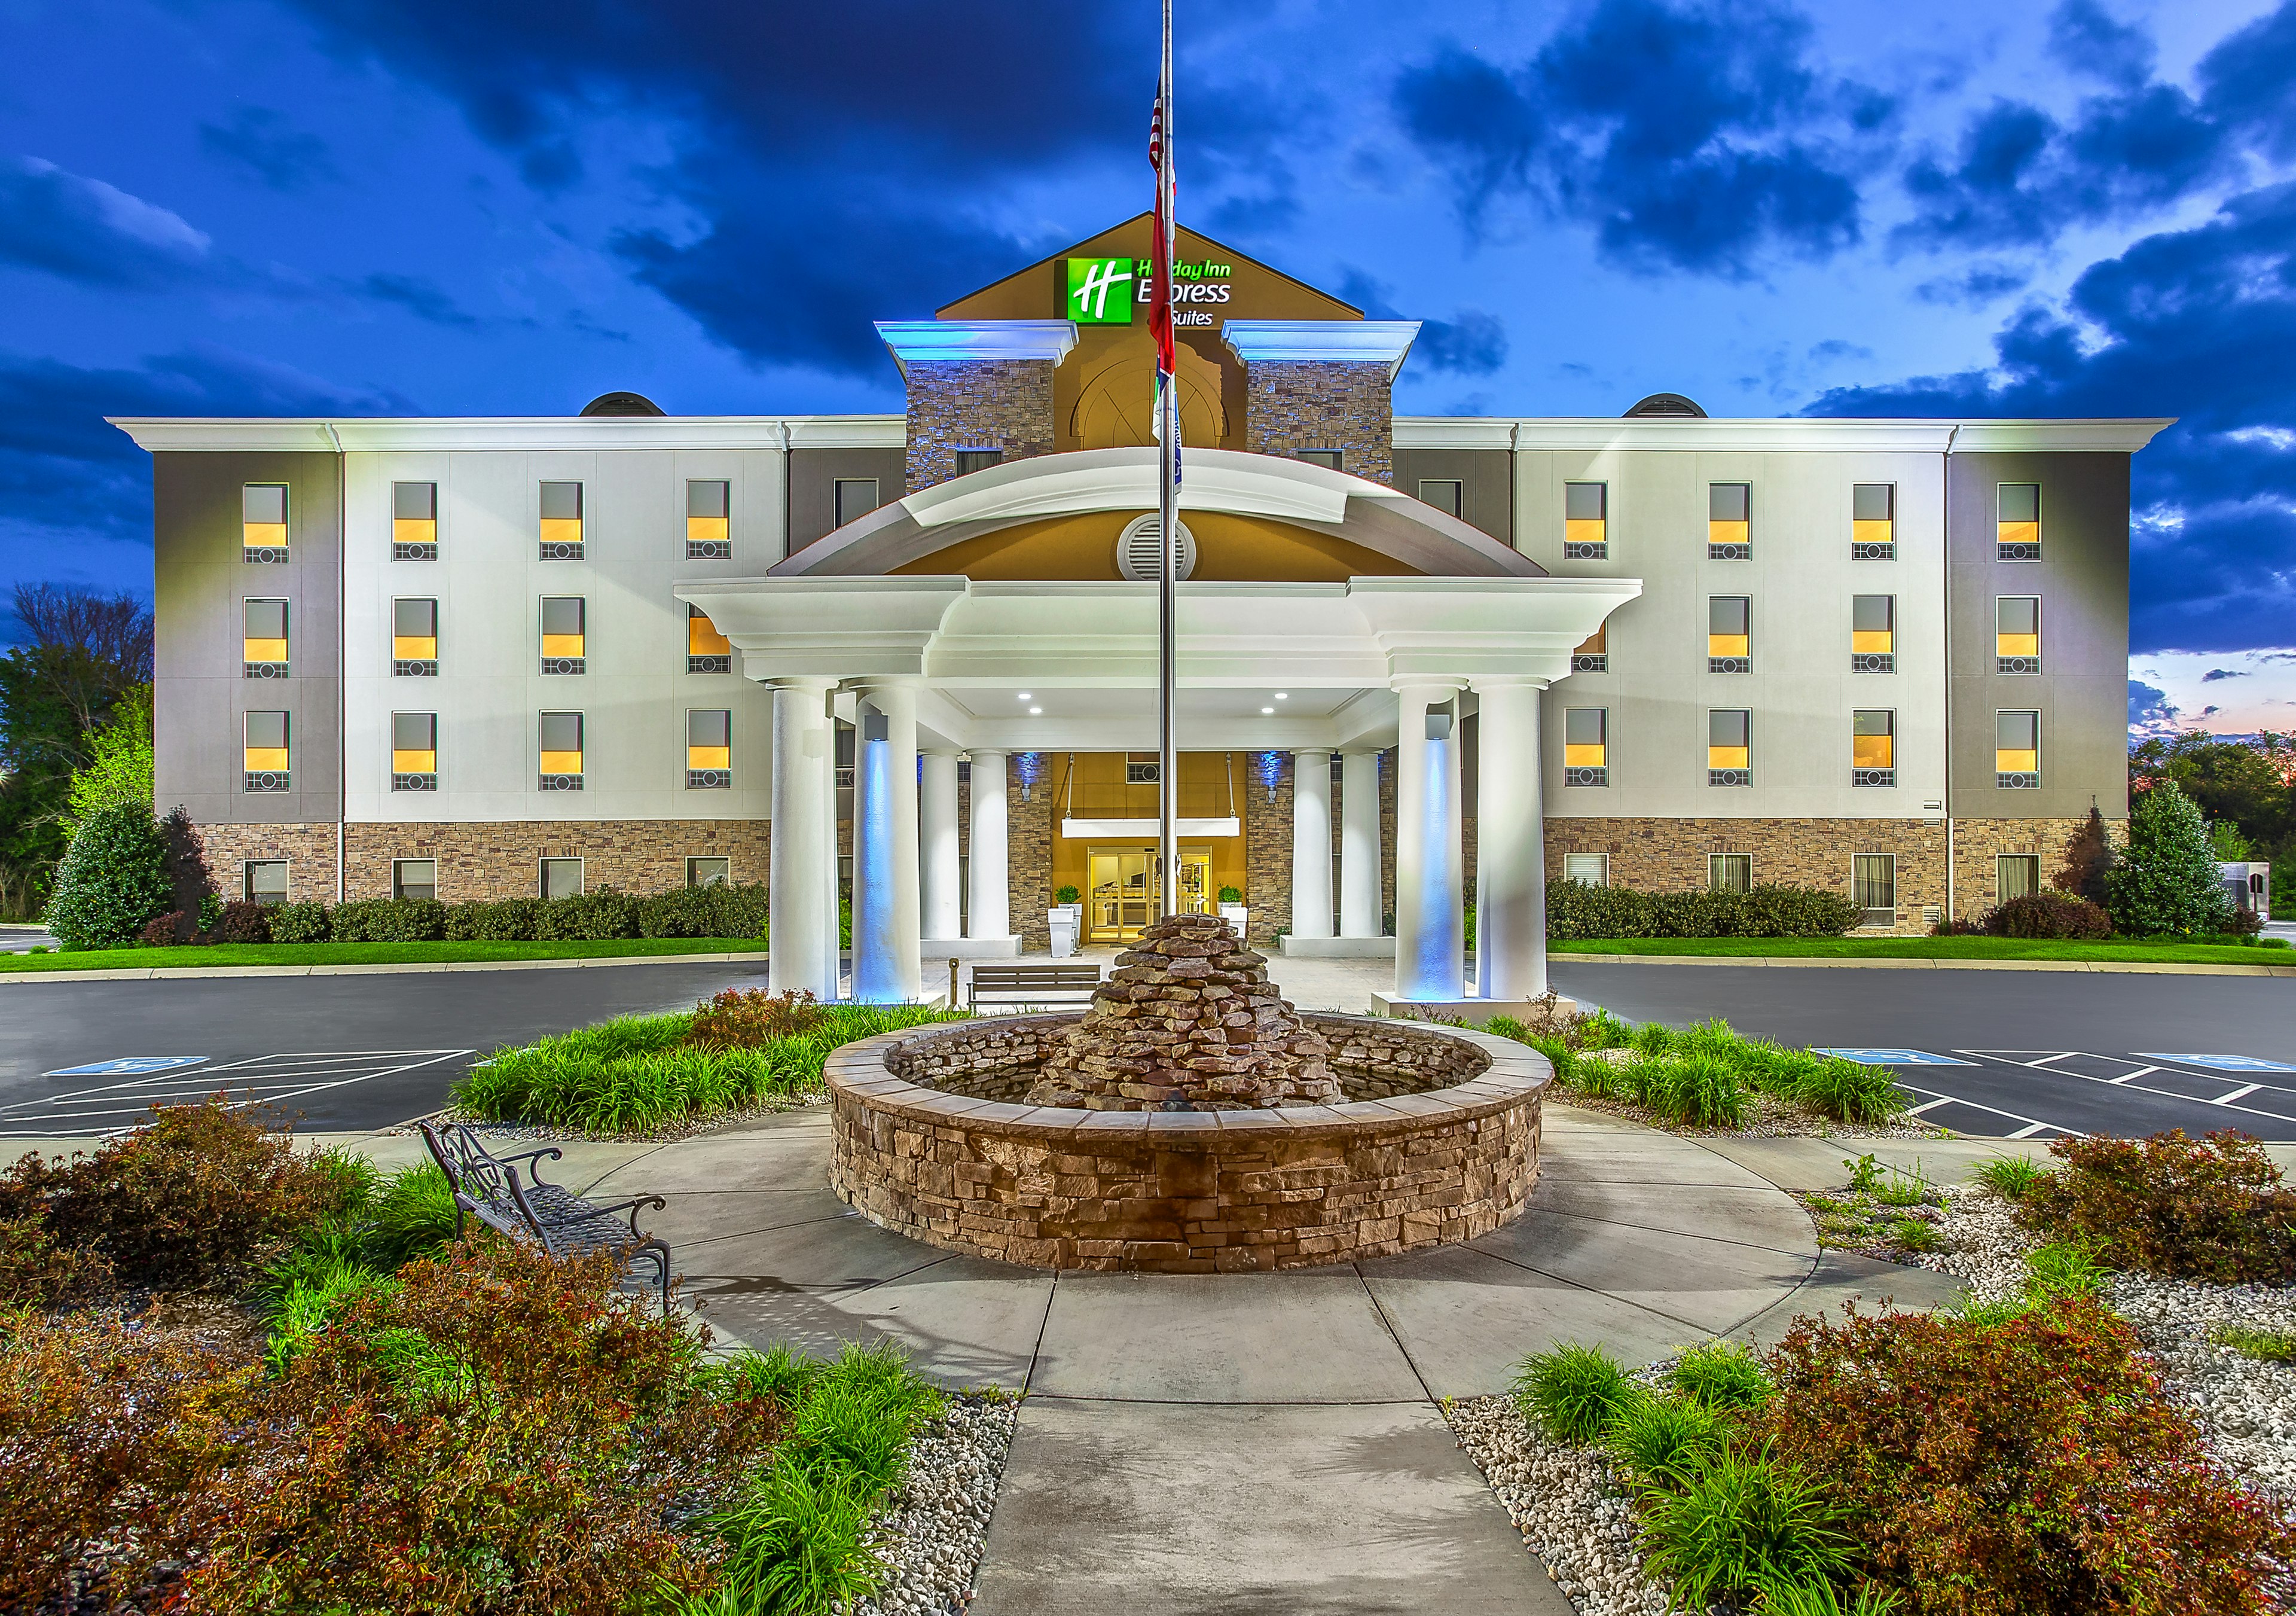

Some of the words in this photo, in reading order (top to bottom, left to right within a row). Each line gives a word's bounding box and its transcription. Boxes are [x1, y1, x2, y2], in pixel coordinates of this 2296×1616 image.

[1137, 259, 1202, 280] Hday
[1204, 259, 1231, 277] Inn
[1138, 279, 1231, 303] Epress
